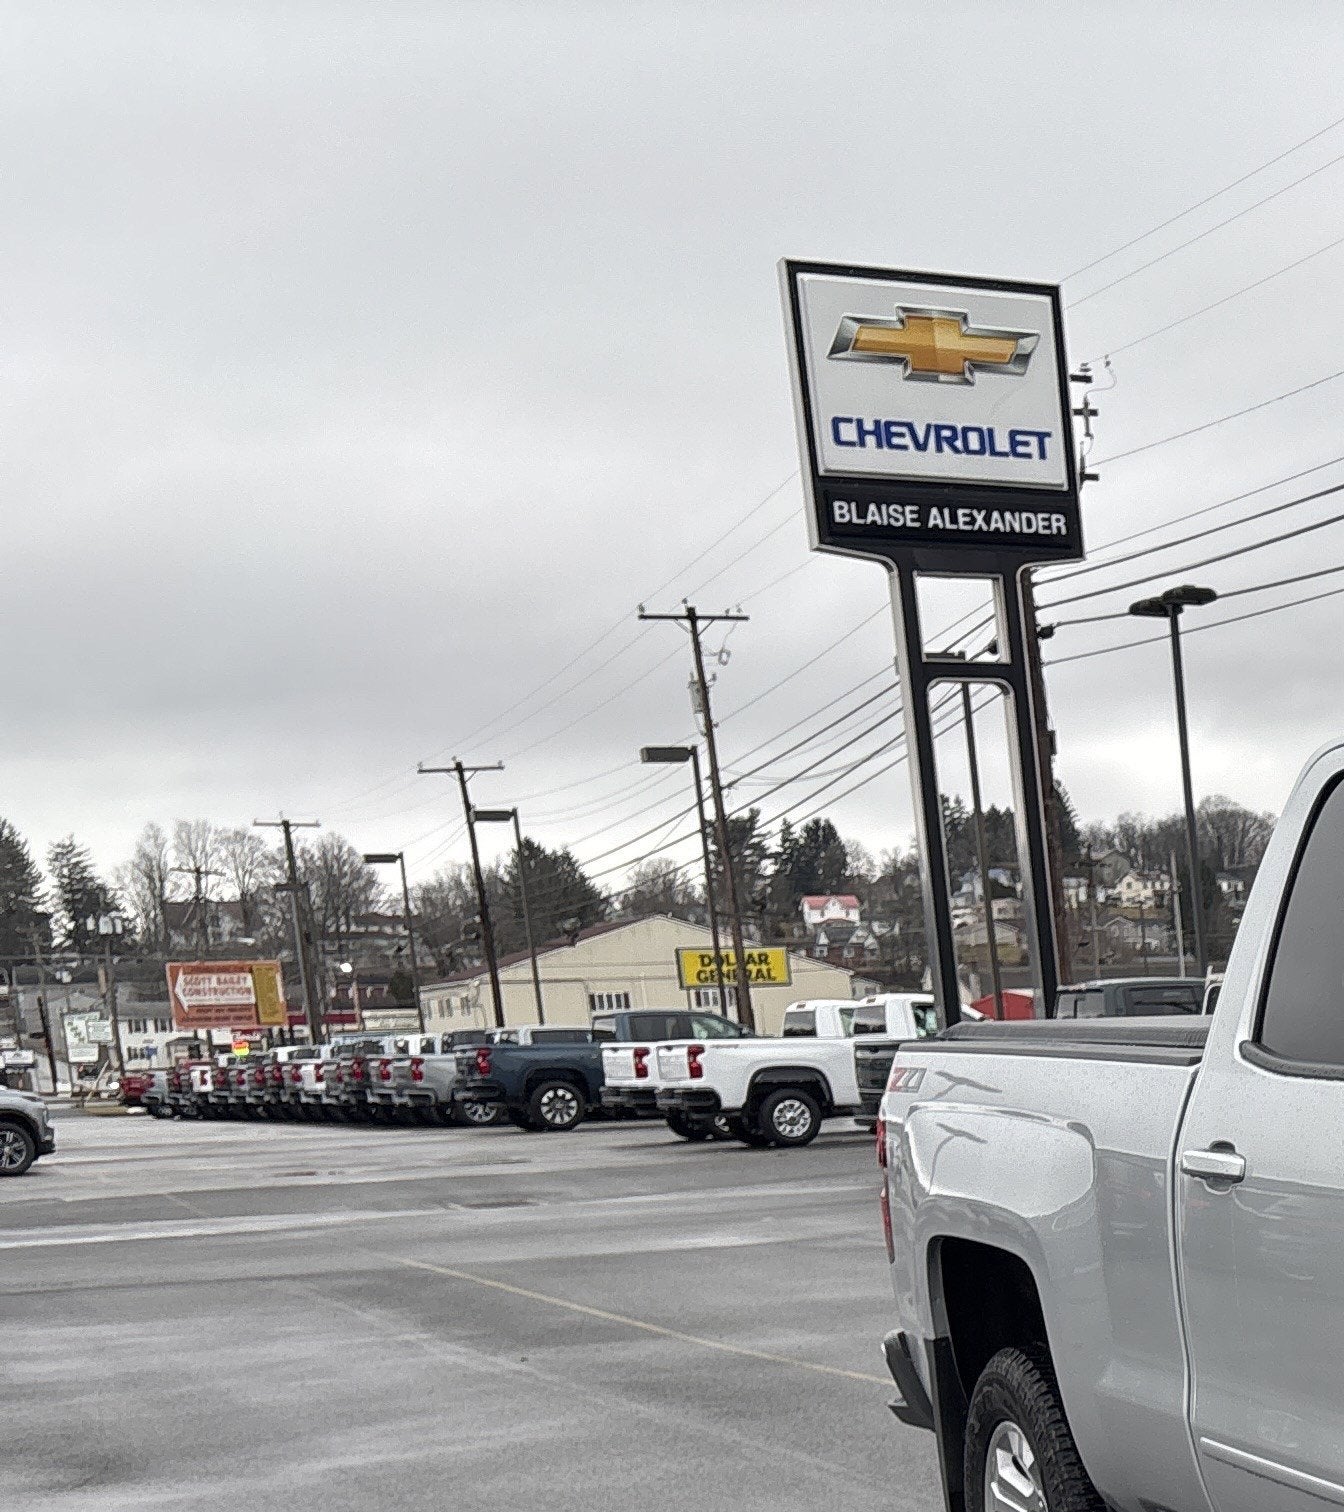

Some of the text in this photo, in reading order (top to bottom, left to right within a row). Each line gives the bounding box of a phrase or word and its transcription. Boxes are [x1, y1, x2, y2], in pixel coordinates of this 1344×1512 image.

[831, 415, 1052, 461] CHEVROLET
[832, 500, 1067, 536] BLAISE ALEXANDER
